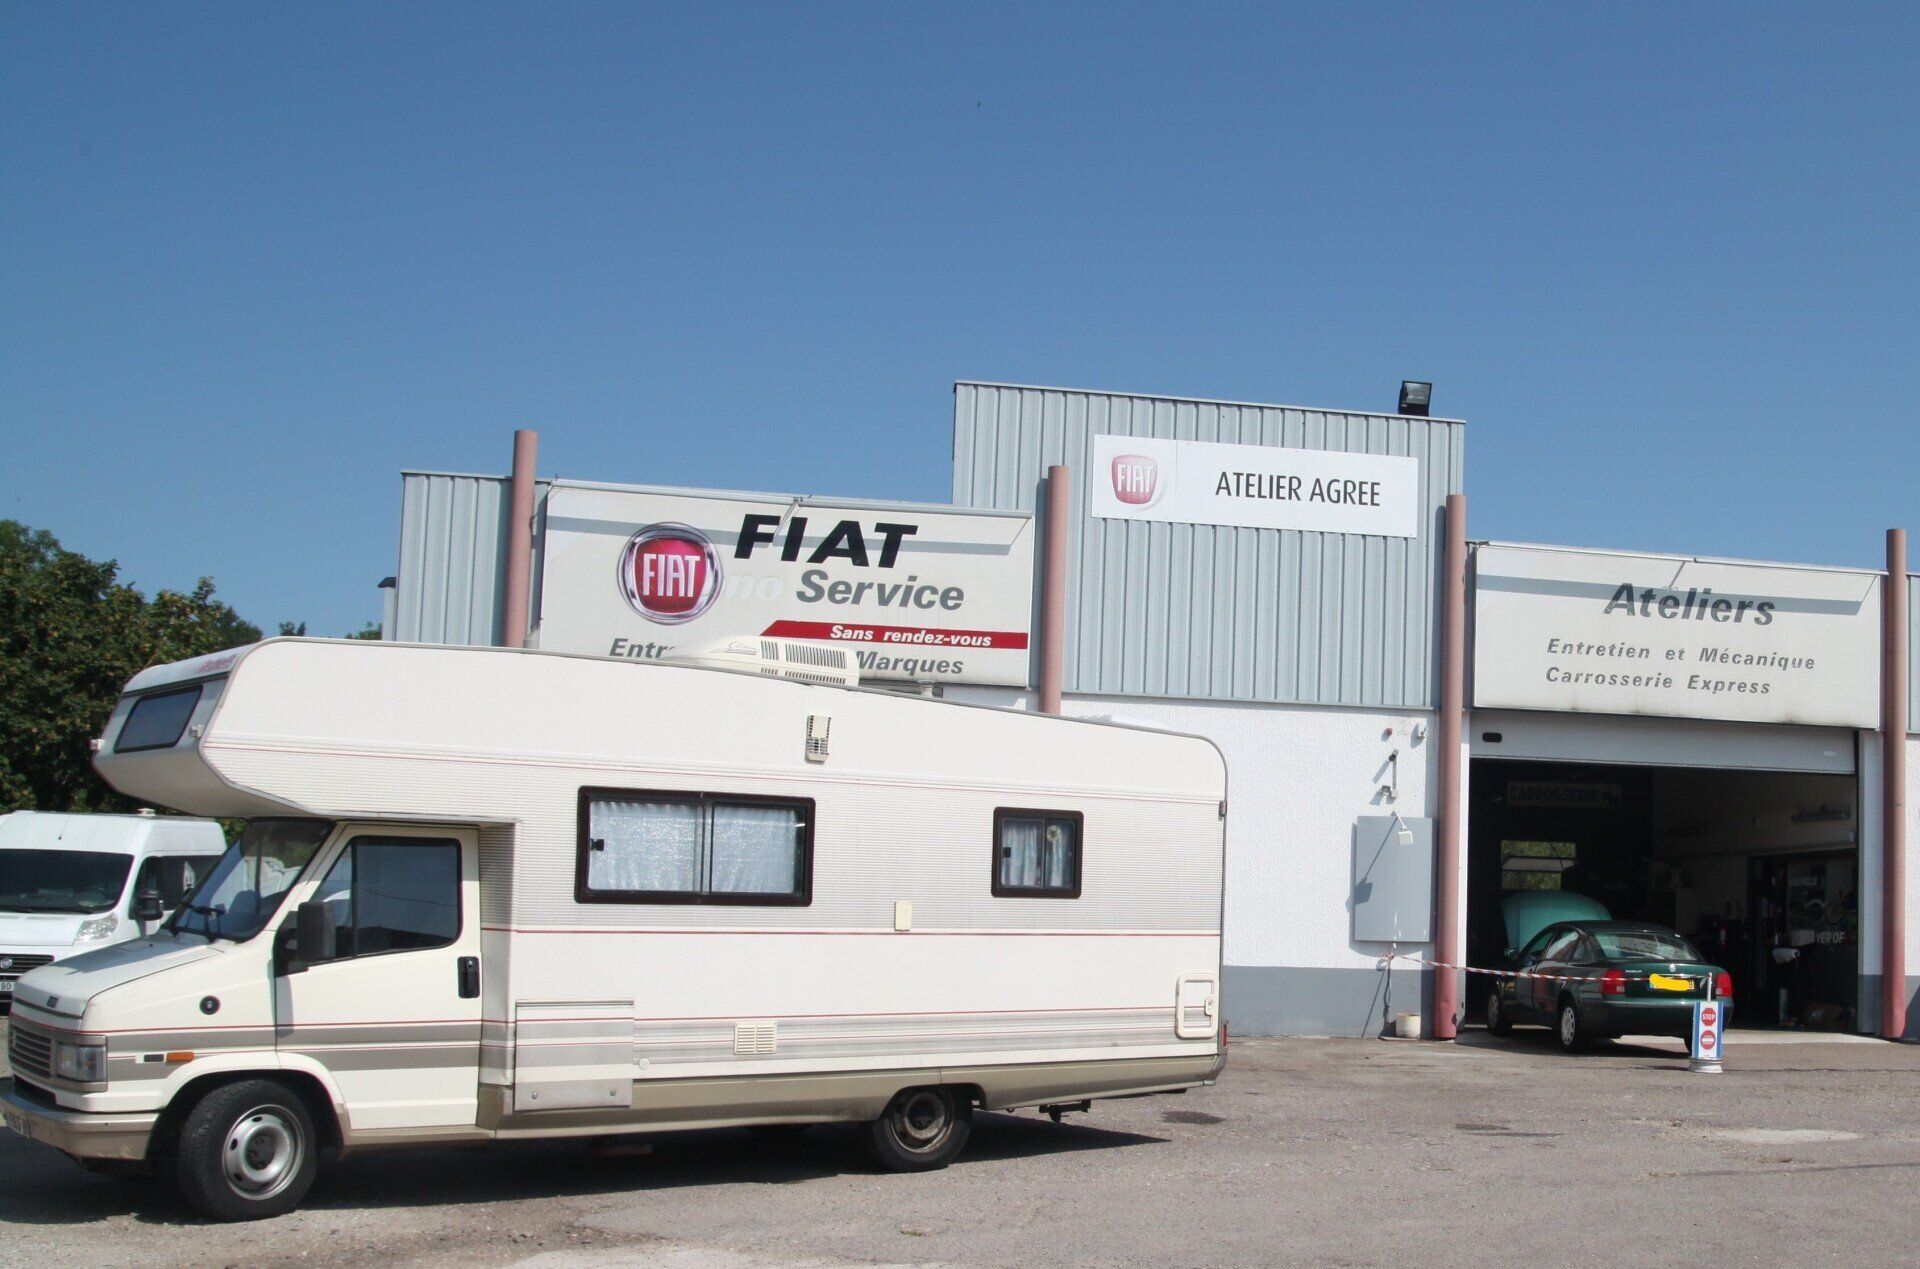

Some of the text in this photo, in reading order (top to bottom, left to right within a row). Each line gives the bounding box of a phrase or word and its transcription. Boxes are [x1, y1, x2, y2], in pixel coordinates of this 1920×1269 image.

[1116, 463, 1154, 494] FIAT
[1215, 471, 1381, 507] ATELIER AGREE
[734, 513, 919, 569] FIAT
[643, 553, 701, 598] FIAT
[796, 569, 965, 611] Service
[1603, 582, 1776, 626] Ateliers
[830, 624, 992, 647] Sans rendez-vous
[855, 650, 965, 677] Marques
[1547, 638, 1816, 671] Entretien et Mécanique
[1546, 666, 1771, 695] Carrosserie Express
[1702, 1013, 1716, 1021] STOP
